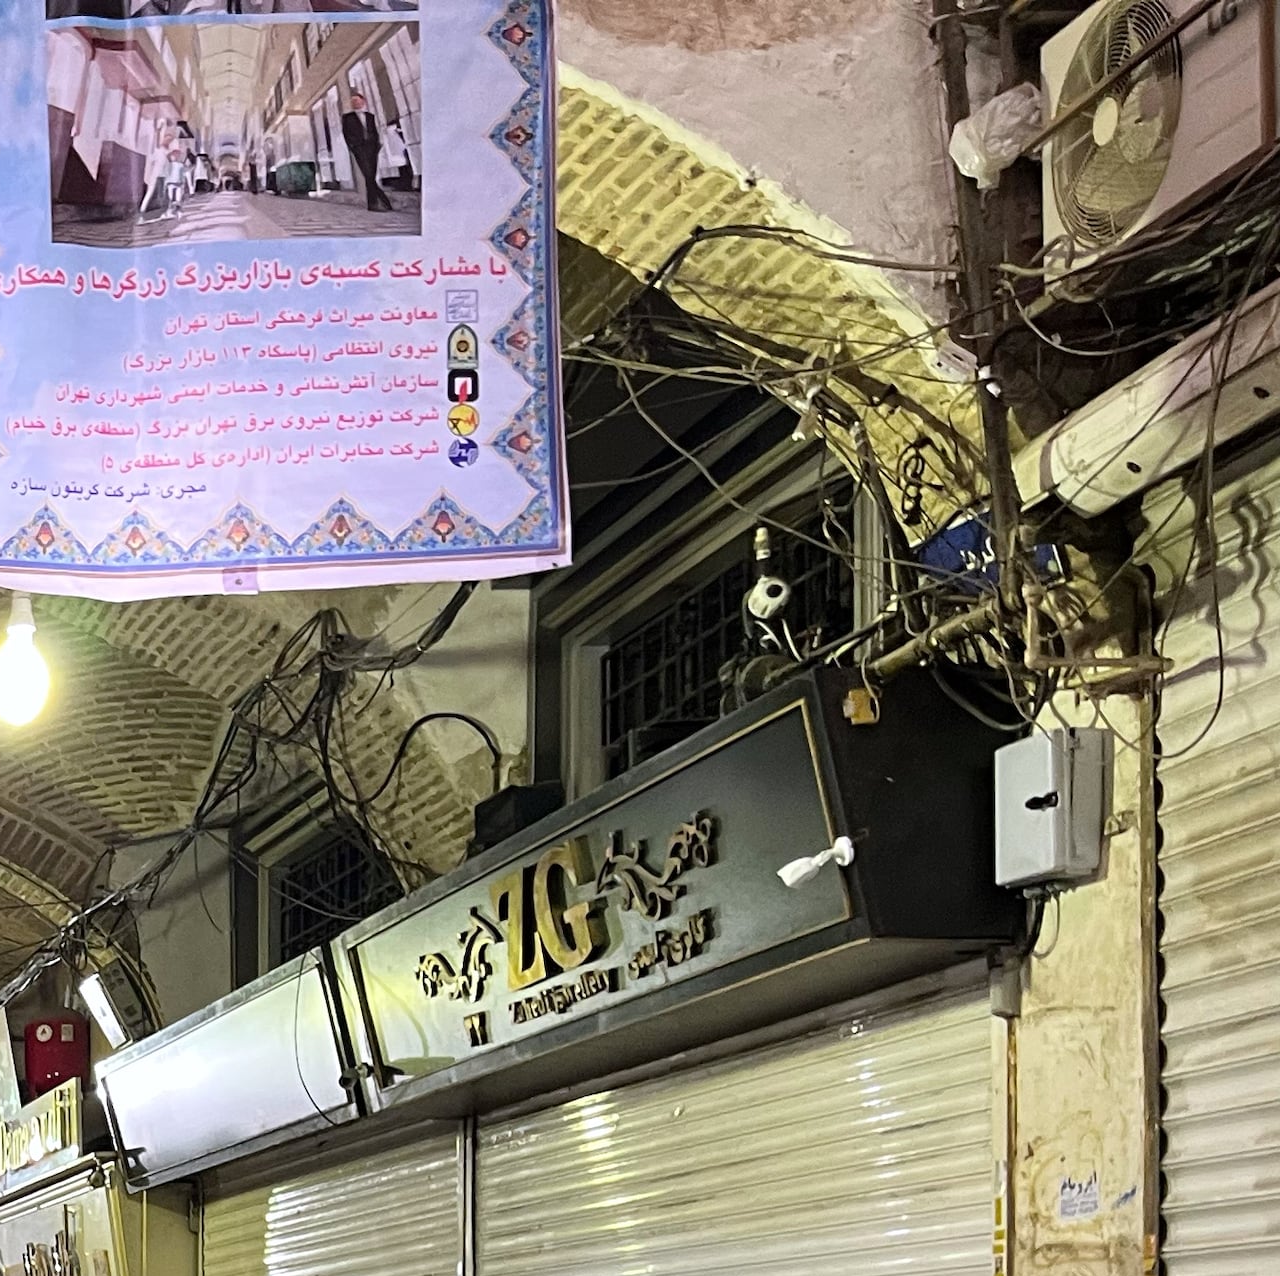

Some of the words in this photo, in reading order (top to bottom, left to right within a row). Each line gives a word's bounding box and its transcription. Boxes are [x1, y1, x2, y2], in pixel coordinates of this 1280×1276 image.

[390, 255, 481, 285] مشارکت
[489, 256, 507, 284] با
[73, 274, 85, 294] و
[91, 269, 167, 299] زرگرها
[165, 316, 208, 336] تهران
[214, 311, 260, 332] استان
[265, 309, 323, 330] فرهنگی
[329, 309, 374, 328] میراث
[380, 308, 439, 326] معاونت
[178, 349, 216, 370] بازار
[323, 341, 383, 362] انتظامی
[388, 341, 439, 361] نیروی
[122, 352, 172, 375] بزرگ)
[55, 383, 90, 404] تهران
[167, 382, 211, 404] ایمنی
[216, 378, 269, 397] خدمات
[275, 382, 284, 397] و
[381, 374, 439, 394] سازمان
[94, 386, 162, 408] شهرداری
[195, 416, 237, 435] تهران
[243, 411, 275, 433] برق
[281, 413, 331, 432] نیروی
[336, 410, 384, 431] توزیع
[389, 406, 439, 427] شرکت
[51, 417, 77, 437] برق
[147, 420, 189, 439] بزرگ
[186, 452, 206, 469] کل
[276, 446, 314, 466] ایران
[320, 443, 384, 463] مخابرات
[389, 440, 439, 461] شرکت
[104, 482, 151, 502] شرکت
